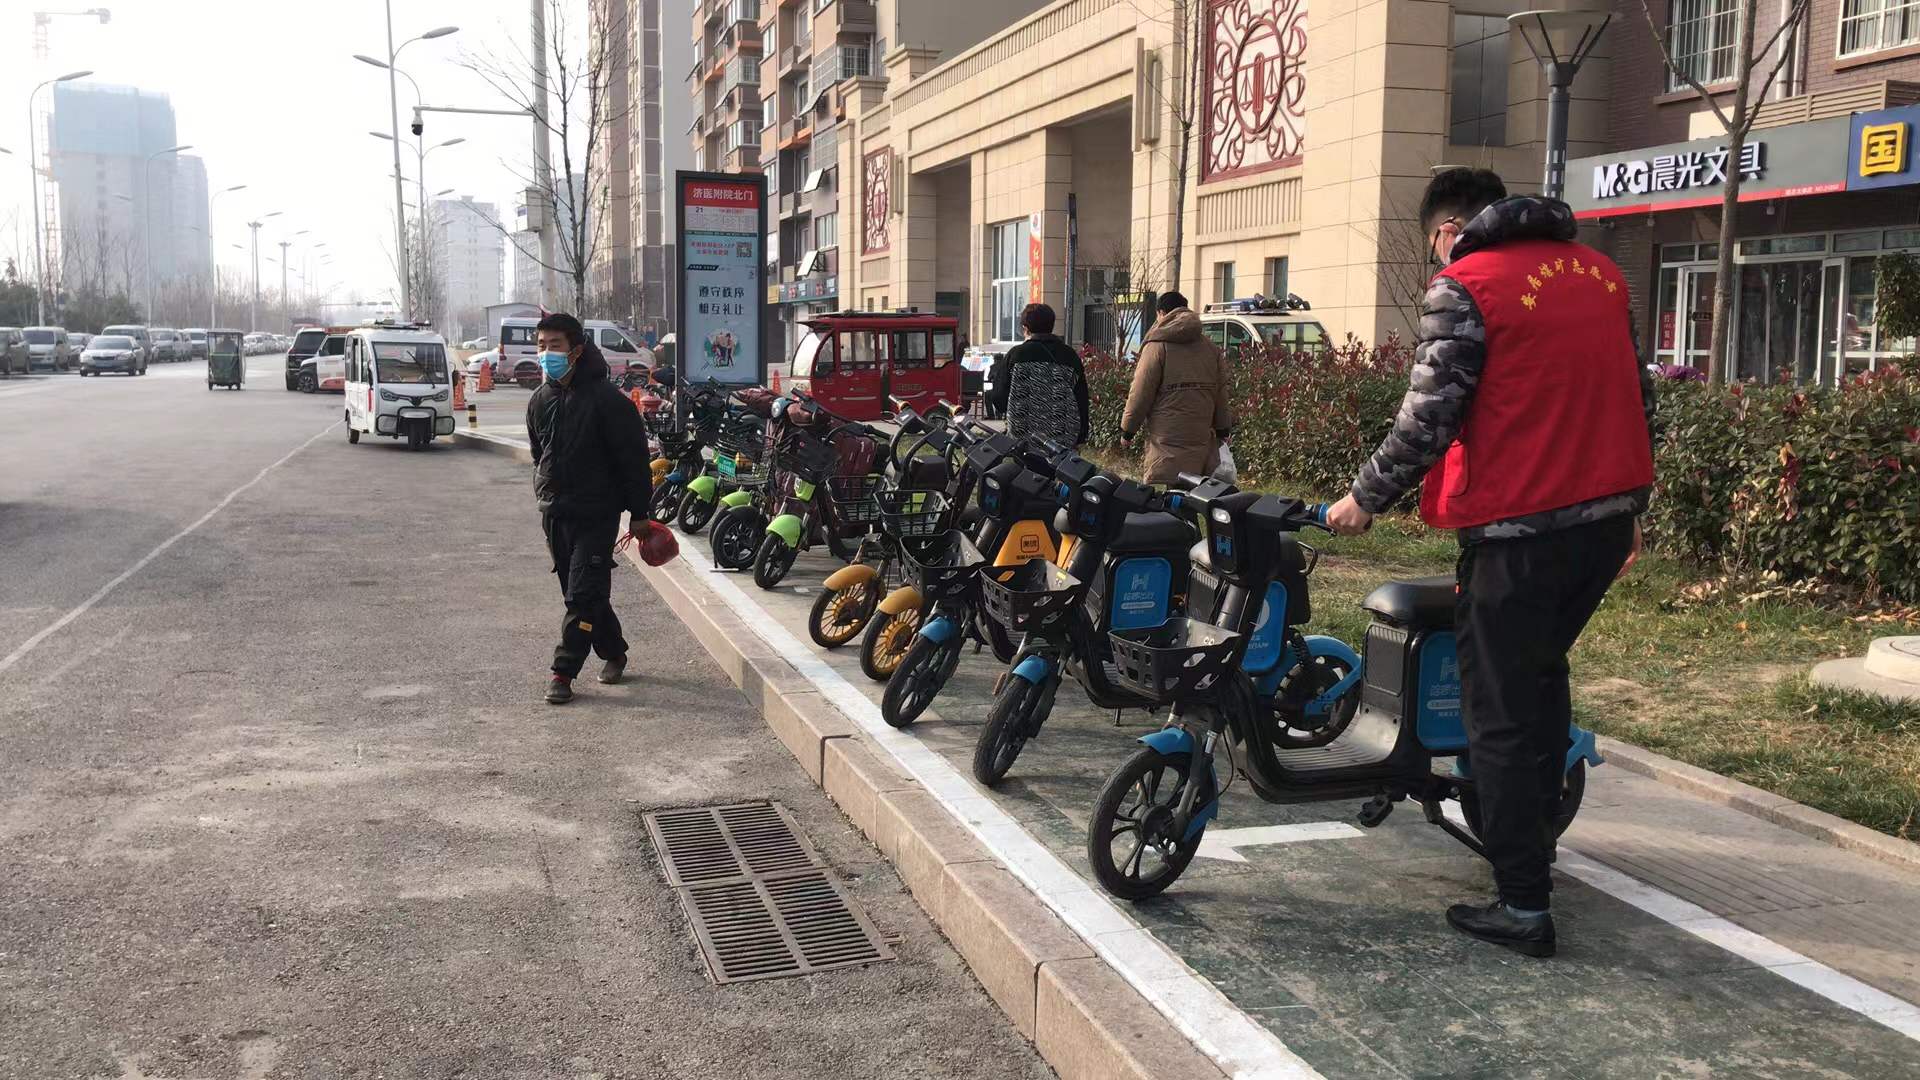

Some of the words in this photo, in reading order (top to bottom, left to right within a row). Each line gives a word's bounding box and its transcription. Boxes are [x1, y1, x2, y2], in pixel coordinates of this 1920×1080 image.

[1651, 141, 1761, 191] 晨光文具
[1860, 122, 1906, 177] 国
[699, 303, 744, 315] 相互礼让
